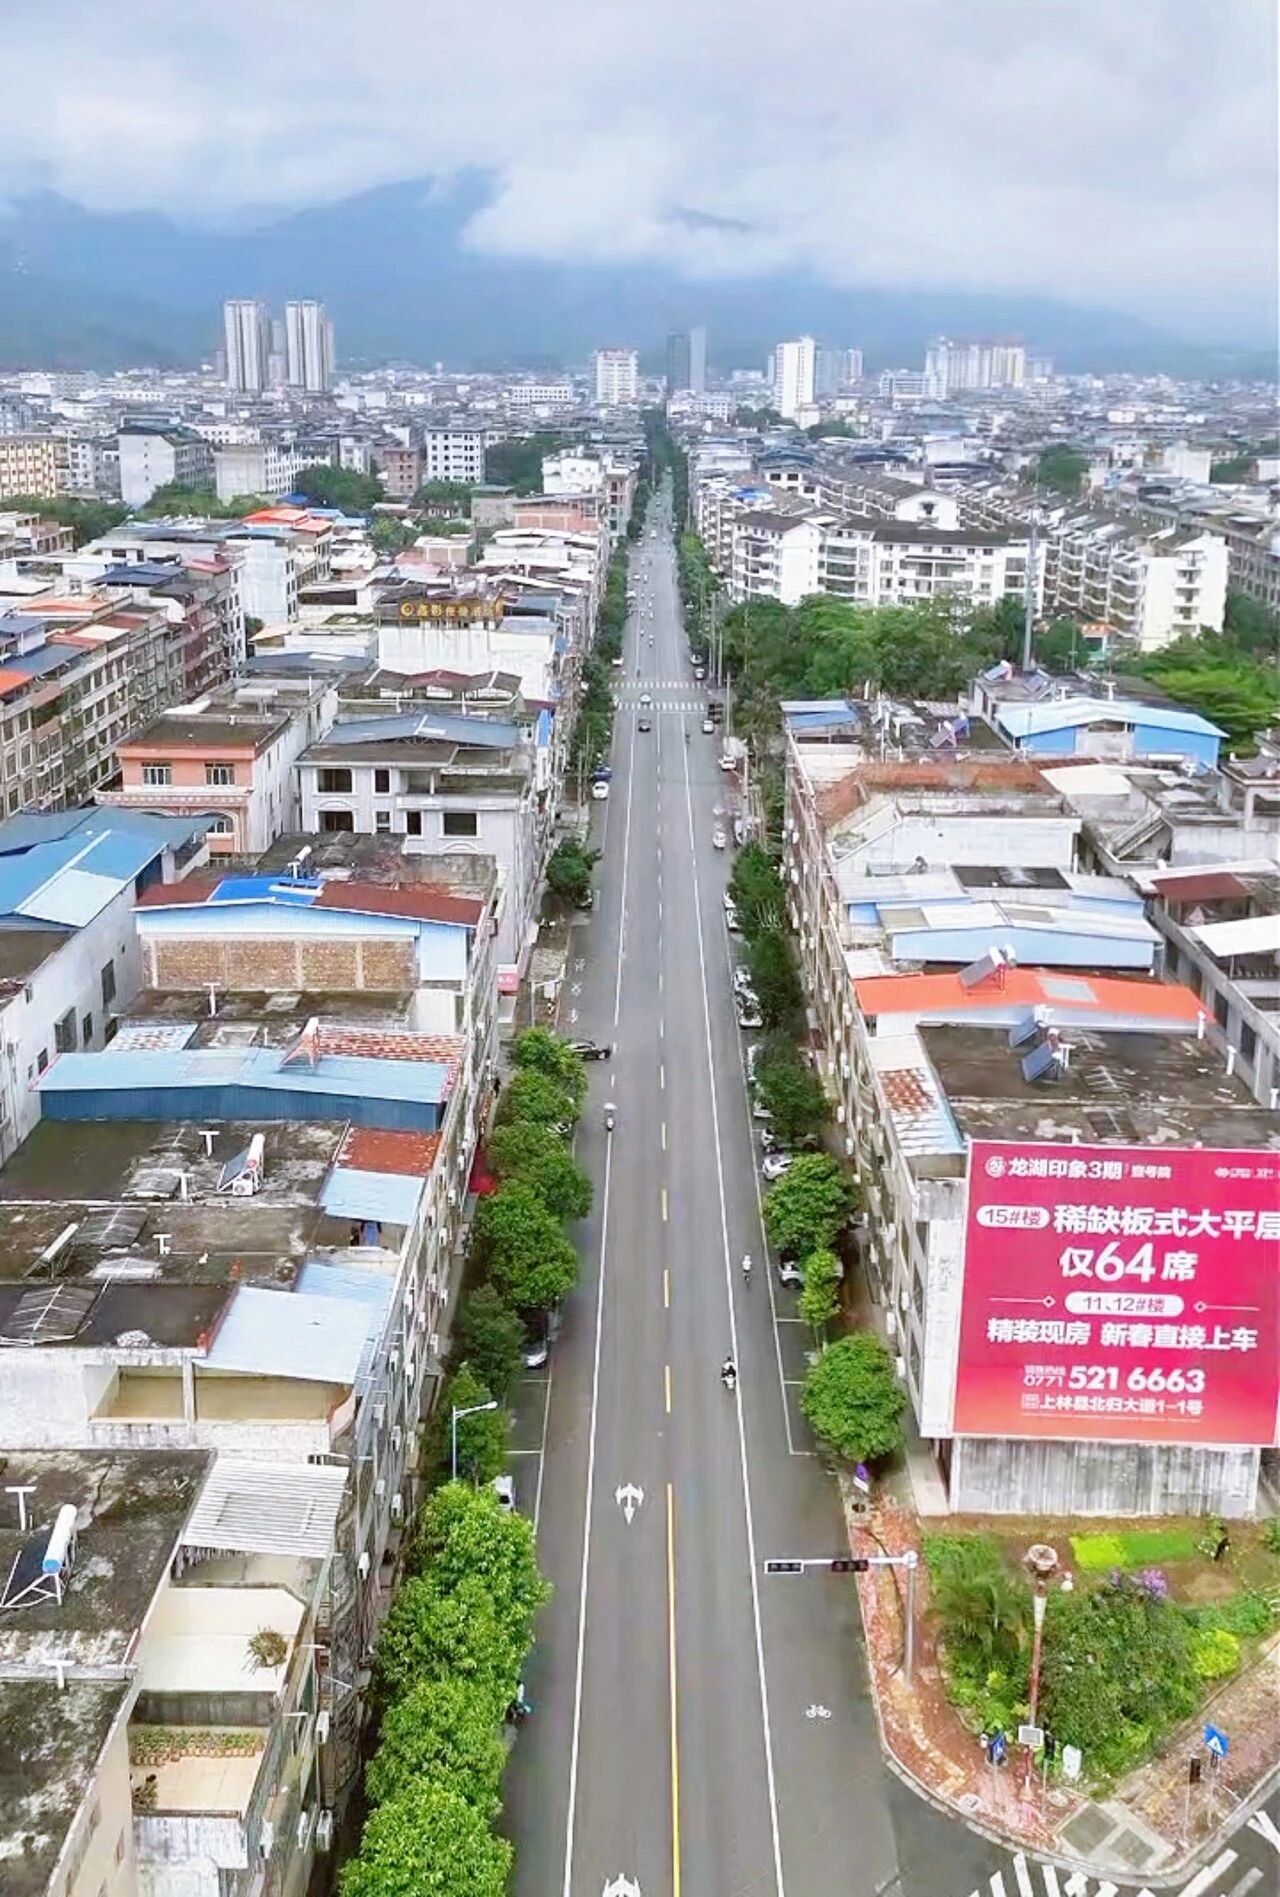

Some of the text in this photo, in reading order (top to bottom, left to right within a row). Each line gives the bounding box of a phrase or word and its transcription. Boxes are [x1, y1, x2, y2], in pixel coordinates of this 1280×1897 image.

[1008, 1157, 1122, 1180] 龙湖印象3期
[985, 1205, 1280, 1240] 15#楼 稀缺板式大平层
[987, 1318, 1258, 1352] 精装现房 新春直接上车
[1024, 1366, 1206, 1393] 0771 521 6663
